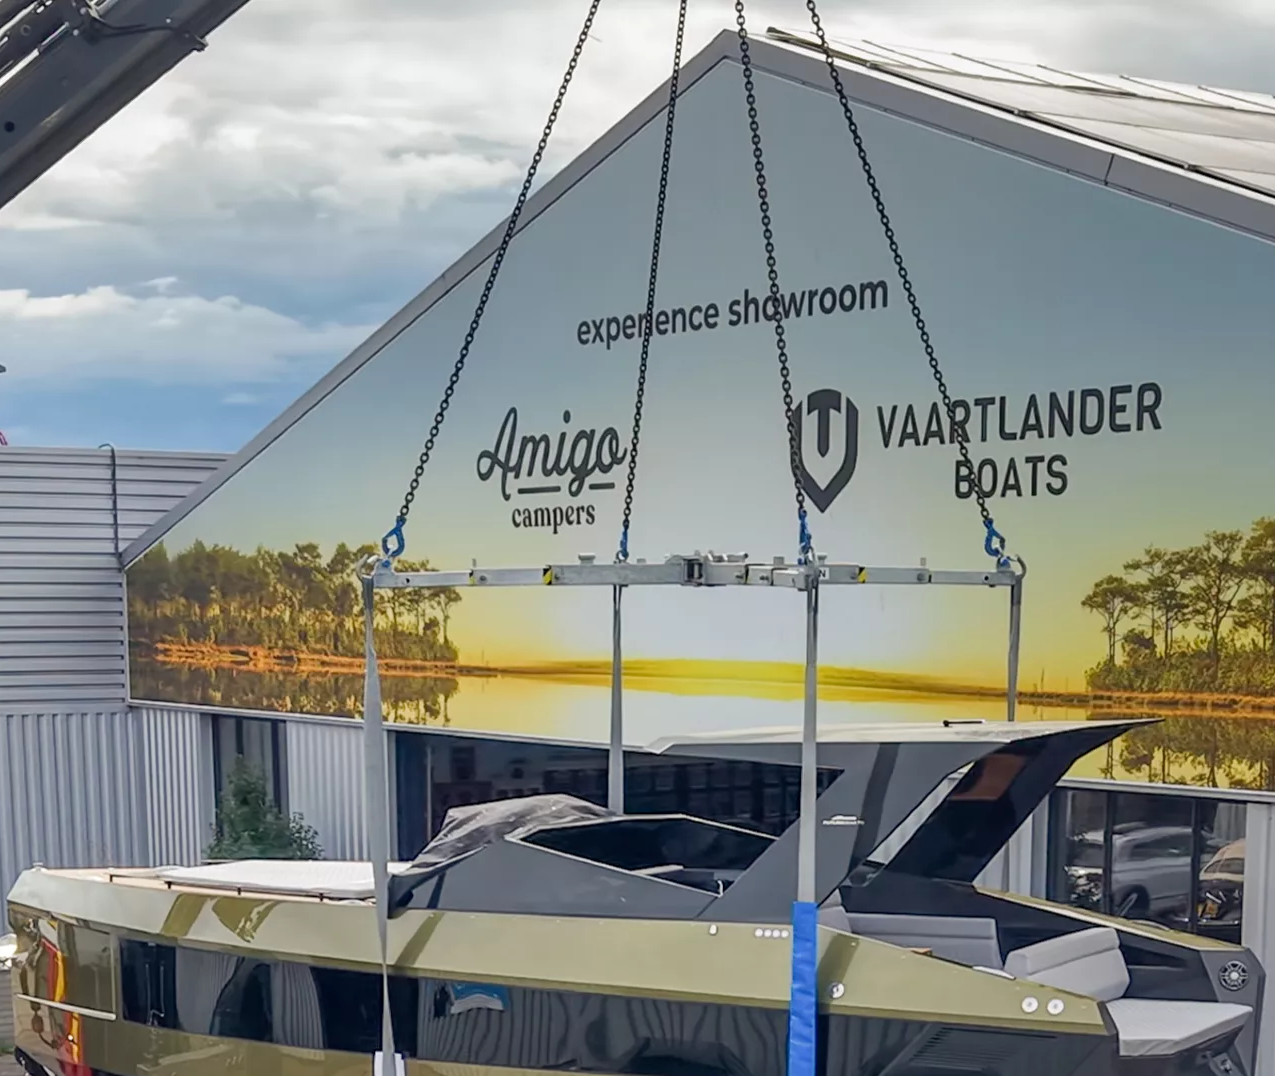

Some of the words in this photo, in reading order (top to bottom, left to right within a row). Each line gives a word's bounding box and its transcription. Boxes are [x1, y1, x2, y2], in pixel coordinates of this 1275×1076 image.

[577, 301, 720, 350] experience
[727, 279, 889, 327] showroom
[876, 381, 1163, 449] VAARTLANDER
[476, 406, 628, 502] Amigo
[954, 453, 1069, 500] BOATS
[511, 503, 596, 535] campers
